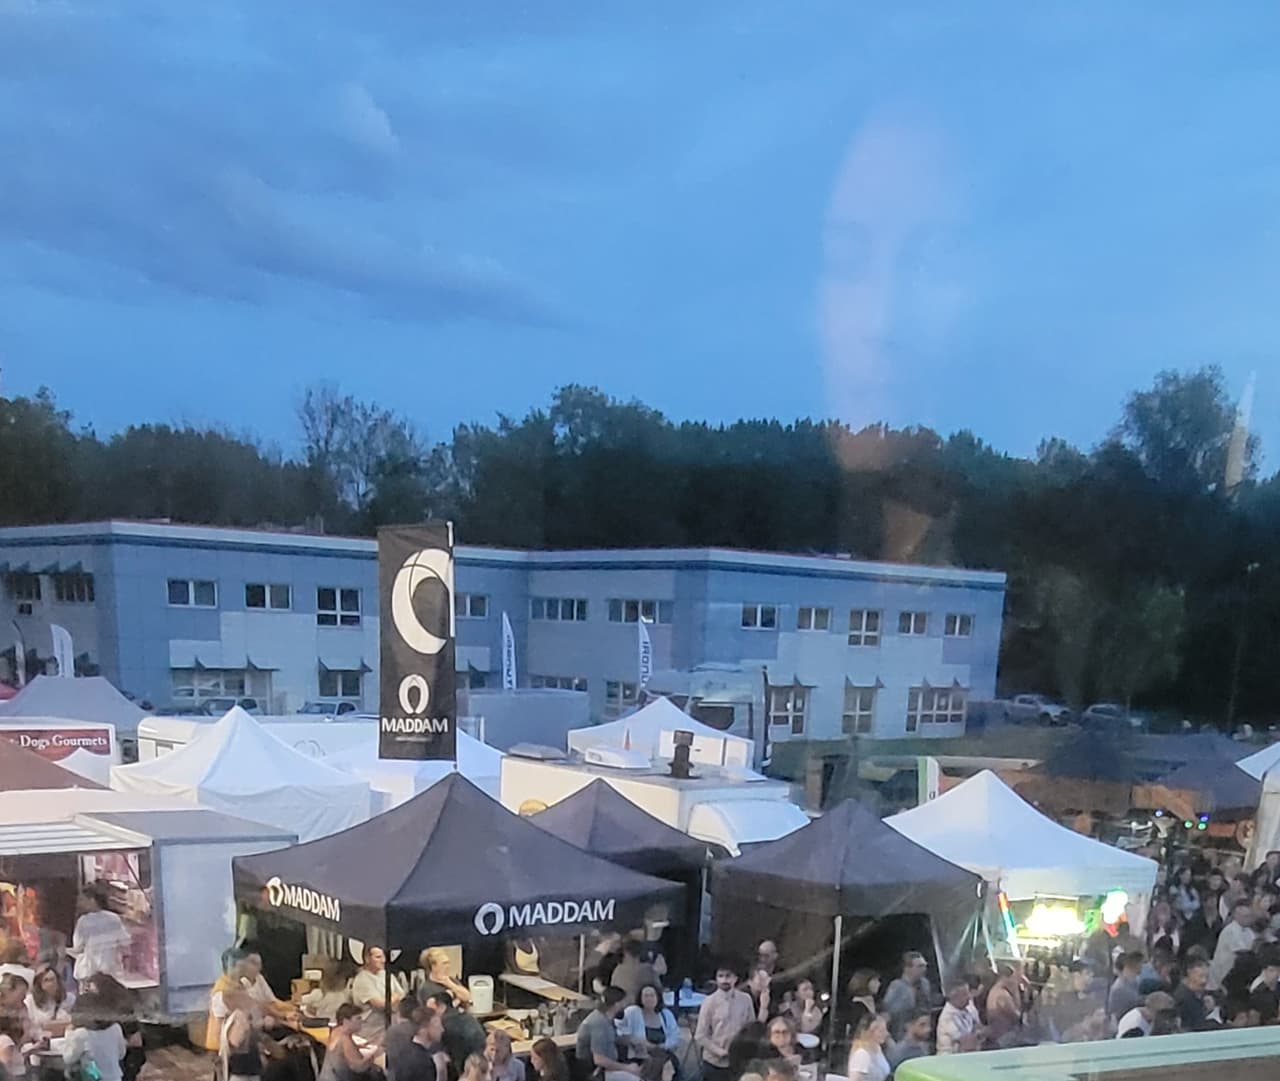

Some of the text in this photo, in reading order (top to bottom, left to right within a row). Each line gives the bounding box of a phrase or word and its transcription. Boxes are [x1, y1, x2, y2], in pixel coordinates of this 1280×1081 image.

[381, 717, 449, 733] MADDAM
[52, 734, 107, 746] Gourmets
[282, 885, 340, 921] MADDAM
[509, 899, 616, 927] MADDAM
